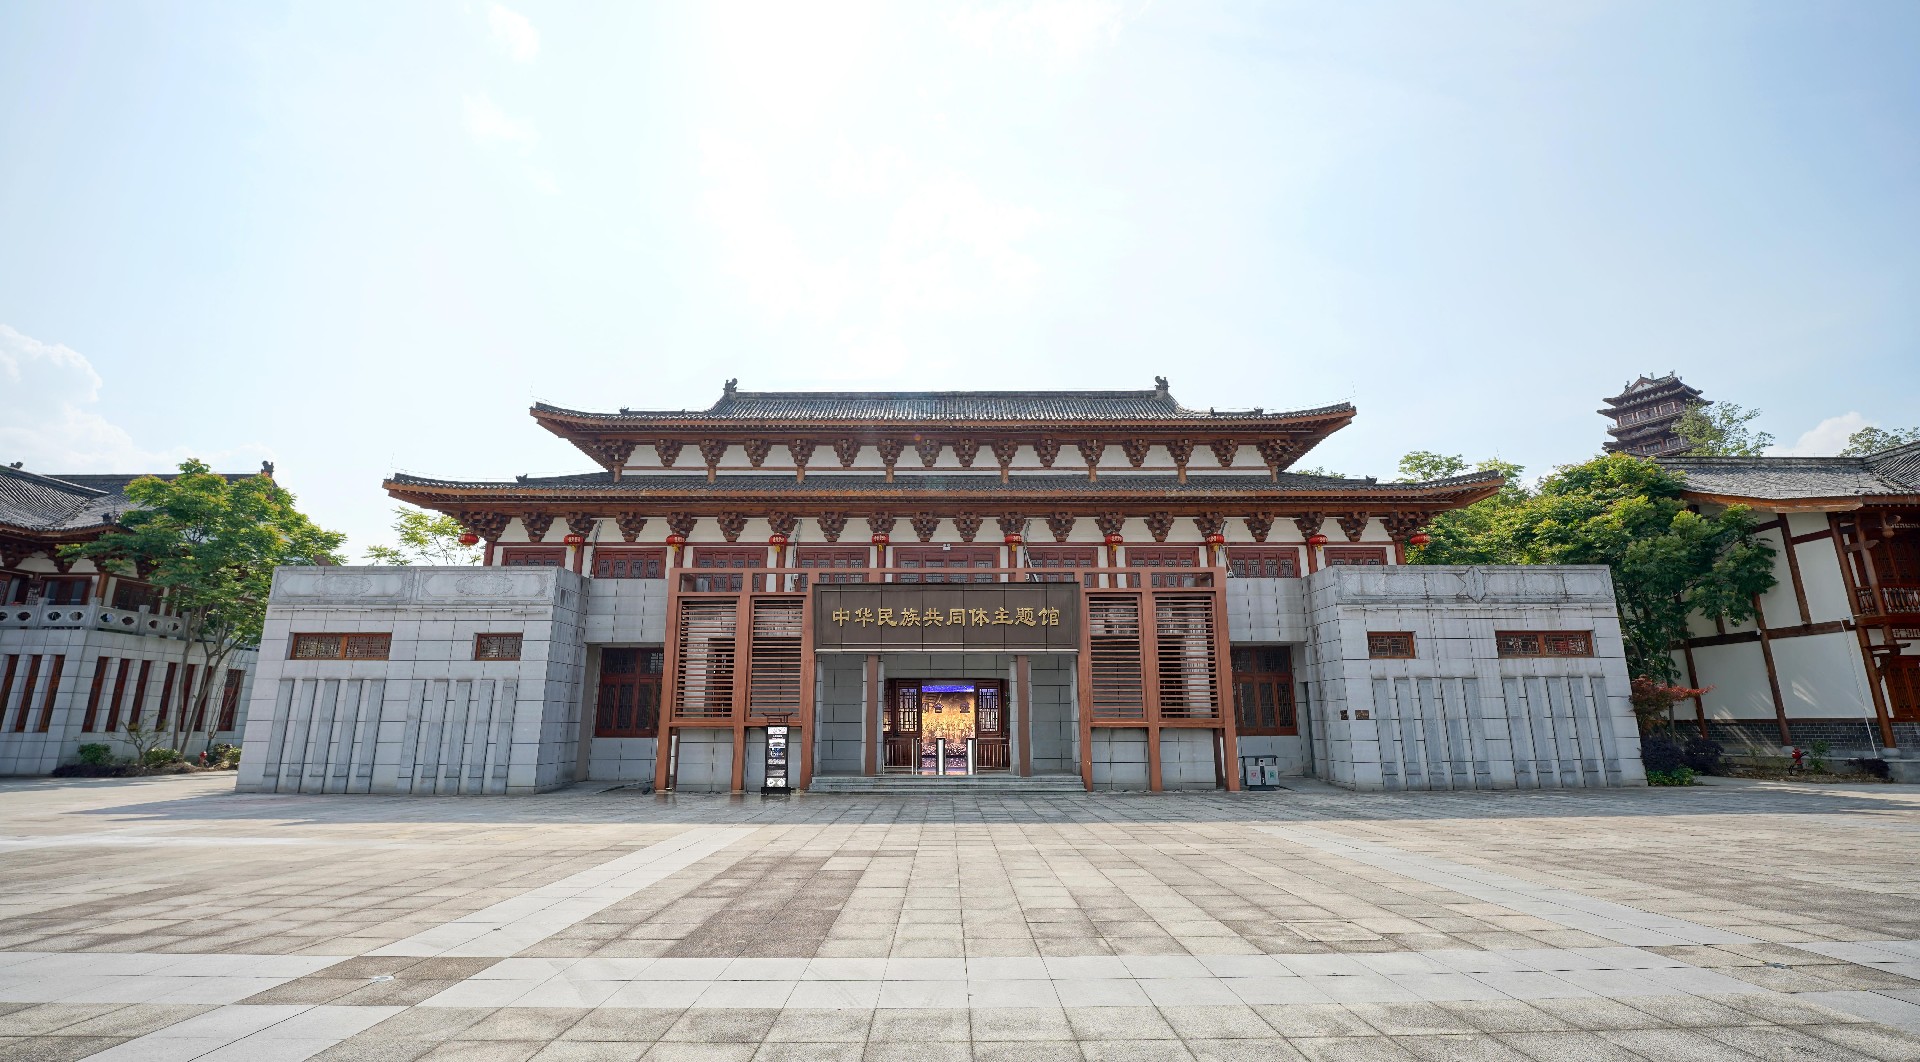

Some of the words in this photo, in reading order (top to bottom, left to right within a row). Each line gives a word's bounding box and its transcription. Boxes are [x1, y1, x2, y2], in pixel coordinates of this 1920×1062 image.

[832, 607, 1060, 627] 中华民族共同体主题馆
